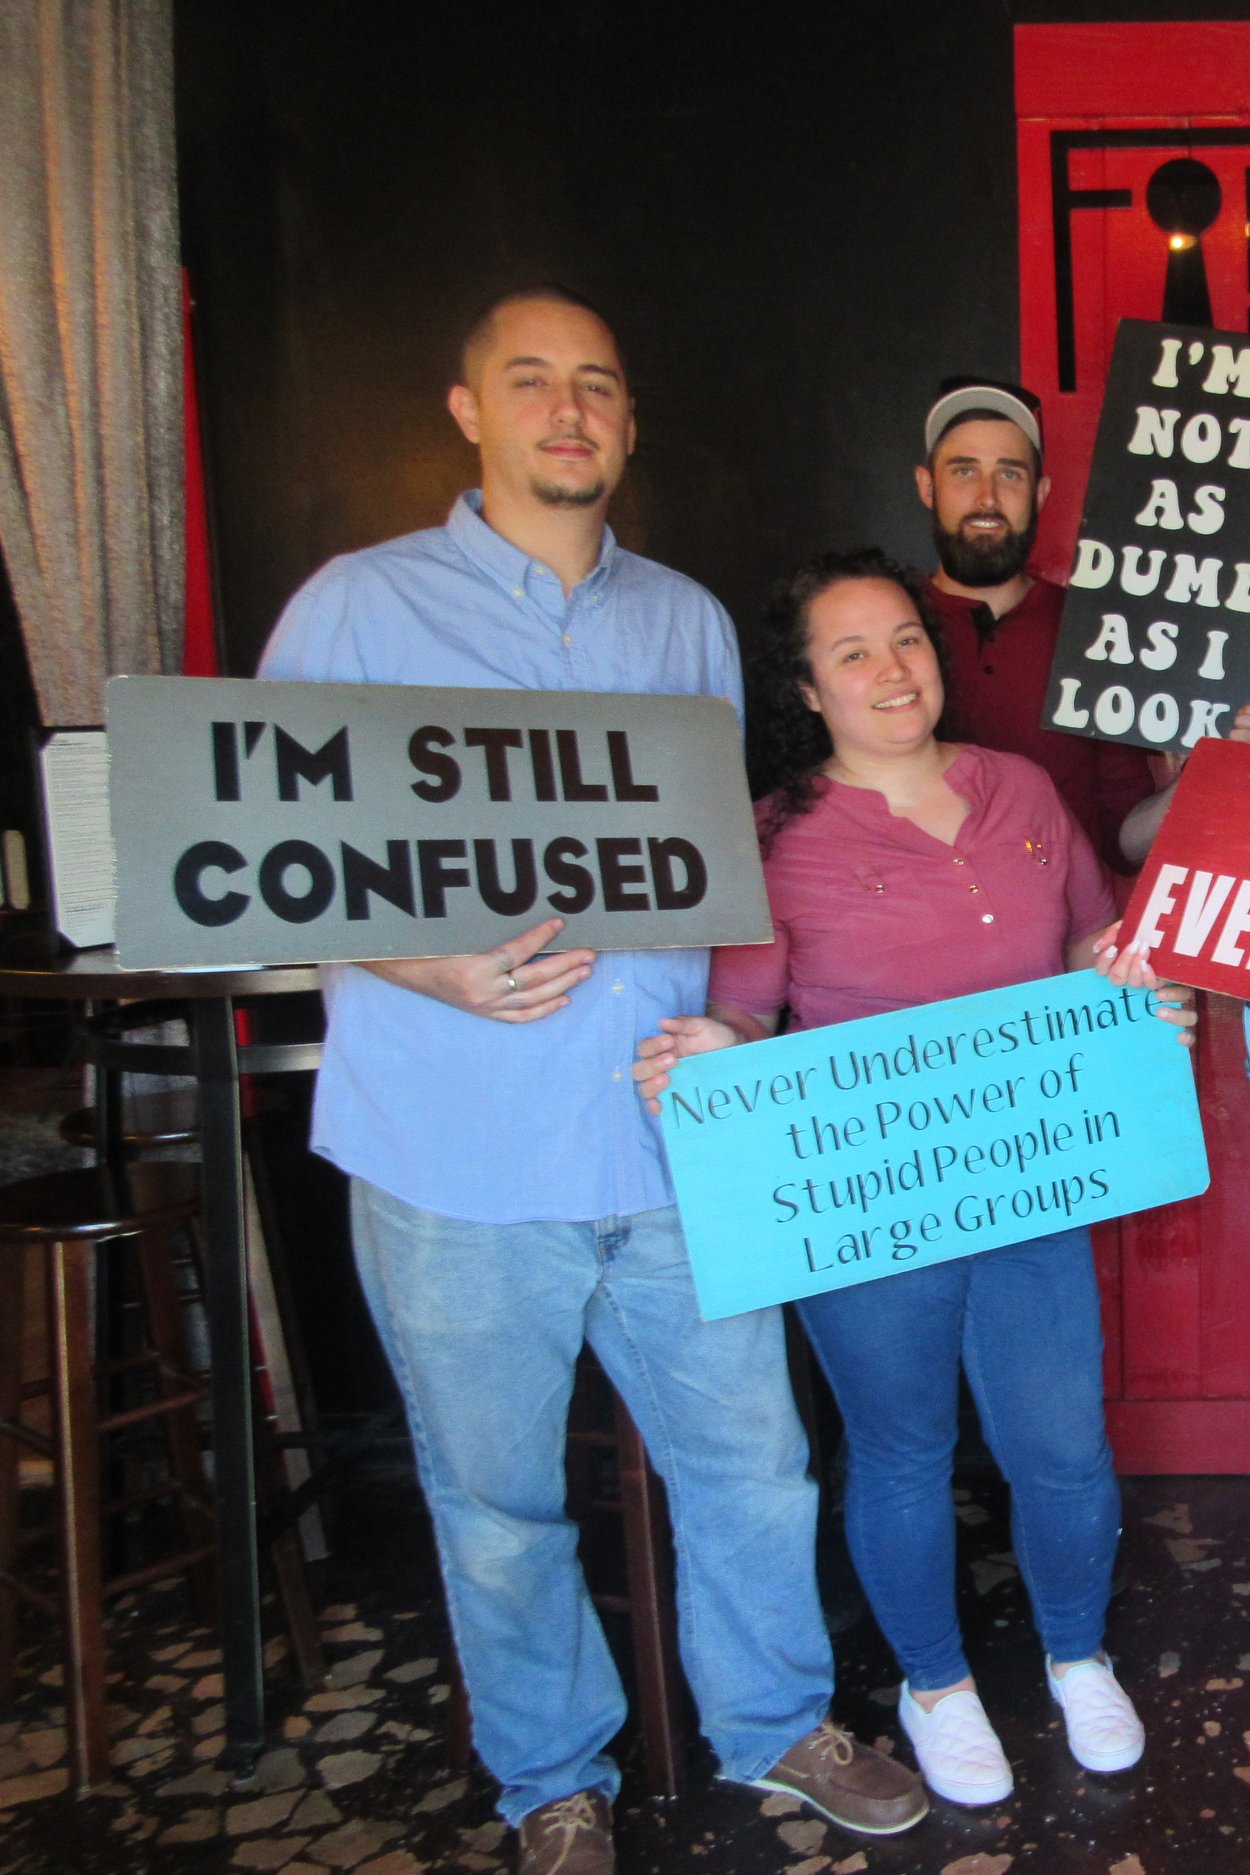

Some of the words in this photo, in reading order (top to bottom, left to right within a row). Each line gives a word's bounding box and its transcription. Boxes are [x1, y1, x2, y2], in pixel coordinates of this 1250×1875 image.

[1134, 479, 1227, 535] AS
[1084, 613, 1181, 671] AS
[1196, 630, 1227, 681] I
[1052, 677, 1231, 749] LOOK
[210, 720, 355, 802] I'M
[408, 724, 660, 804] STILL
[172, 836, 708, 928] CONFUSED
[669, 1064, 819, 1130] Never
[828, 986, 1168, 1093] Underestimate
[785, 1113, 868, 1160] the
[875, 1073, 1027, 1141] Power
[1038, 1052, 1085, 1095] of
[772, 1158, 926, 1224] Stupid
[934, 1116, 1075, 1184] People
[1082, 1107, 1122, 1145] in
[803, 1211, 943, 1274] Large
[953, 1167, 1110, 1234] Groups
